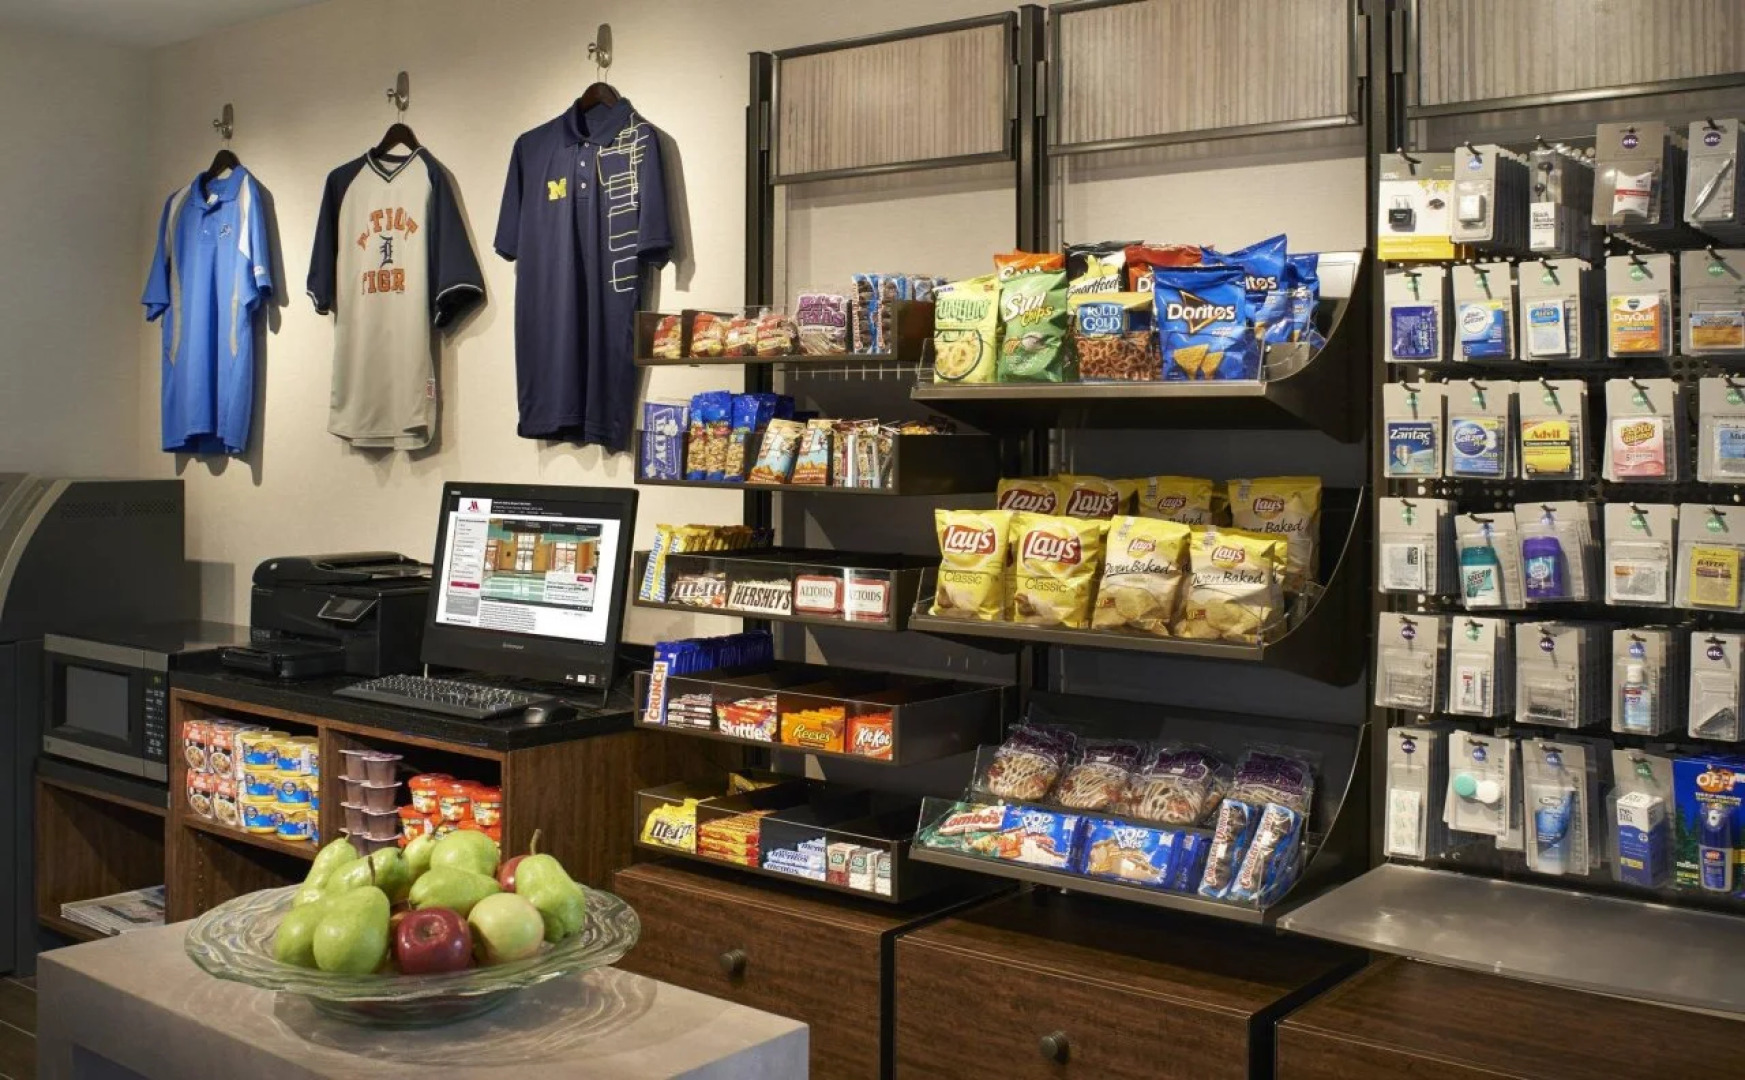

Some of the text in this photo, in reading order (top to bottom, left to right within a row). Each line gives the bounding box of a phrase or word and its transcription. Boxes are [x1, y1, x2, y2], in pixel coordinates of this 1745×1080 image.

[547, 178, 567, 200] M
[1003, 292, 1047, 322] Sun
[1167, 304, 1235, 321] Doritos
[1083, 316, 1121, 332] GOLD
[1614, 312, 1654, 324] DayQuil
[1390, 429, 1431, 440] Zantac
[1531, 428, 1561, 439] Advil
[1003, 490, 1055, 514] Lay's
[1071, 490, 1117, 515] Lay's
[1256, 498, 1284, 511] Lay's
[1265, 520, 1304, 534] Baked
[945, 526, 993, 554] Lay's
[1024, 532, 1078, 560] Lay's
[1130, 538, 1156, 551] Lay's
[1213, 546, 1243, 561] Lay's
[1132, 559, 1172, 575] Baked
[944, 571, 982, 585] Classic
[1025, 577, 1068, 592] Classic
[1222, 571, 1265, 585] Baked
[733, 585, 792, 610] HERSHEY'S
[801, 586, 833, 597] ALTOIDS
[648, 663, 665, 720] CRUNCH
[719, 719, 772, 742] Skittles
[793, 724, 831, 742] Reese's
